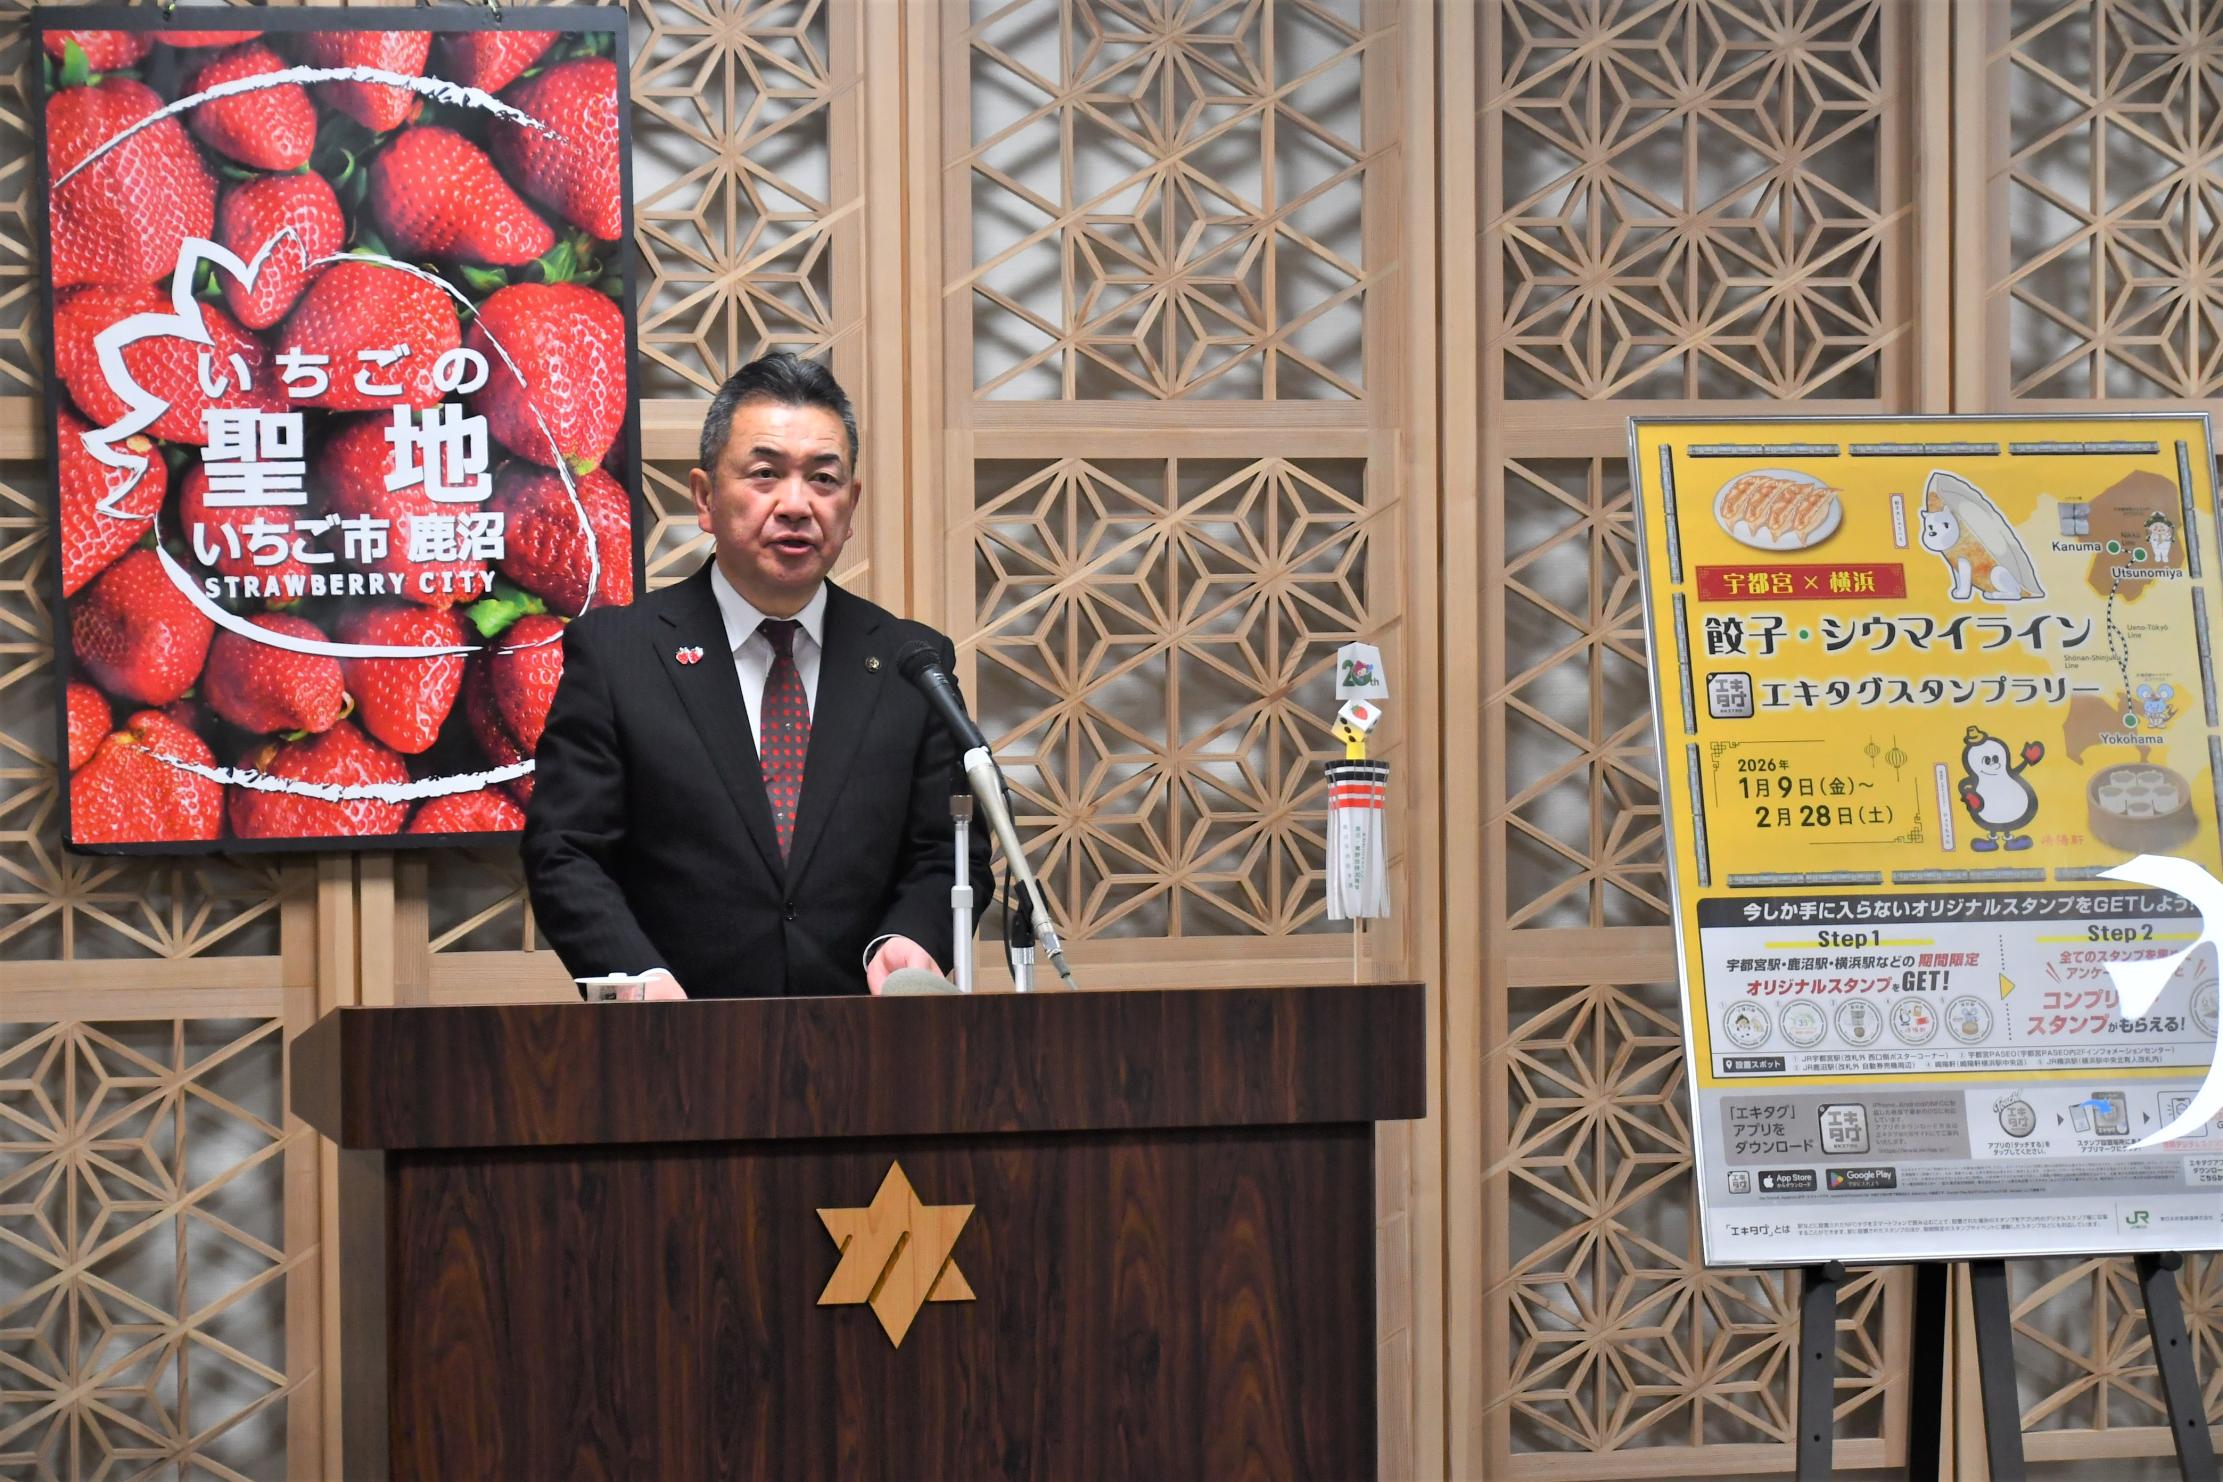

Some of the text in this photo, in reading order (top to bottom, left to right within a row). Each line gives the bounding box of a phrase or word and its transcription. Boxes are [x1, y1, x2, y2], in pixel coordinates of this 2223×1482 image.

[197, 343, 489, 398] いちごの
[201, 403, 492, 507] 聖地
[193, 512, 505, 566] いちご市 鹿沼
[2052, 541, 2101, 552] Kanuma
[1723, 572, 1793, 594] 宇都宮
[1830, 571, 1875, 593] 横浜
[2112, 567, 2183, 580] Utsunomiya
[205, 570, 495, 599] STRAWBERRY CITY
[1705, 614, 2091, 655] 餃子・シウマイライン
[1761, 676, 2100, 707] エキタグスタンプラリー
[2101, 734, 2163, 744] Yokohama
[1738, 758, 1789, 772] 2026年
[1818, 930, 1879, 949] Step 1
[2088, 924, 2153, 943] Step 2
[1733, 1122, 1785, 1137] アプリを
[1735, 1138, 1814, 1155] ダウンロード
[1777, 1174, 1792, 1183] App
[1846, 1170, 1892, 1180] Google Play
[2126, 1210, 2149, 1224] JR
